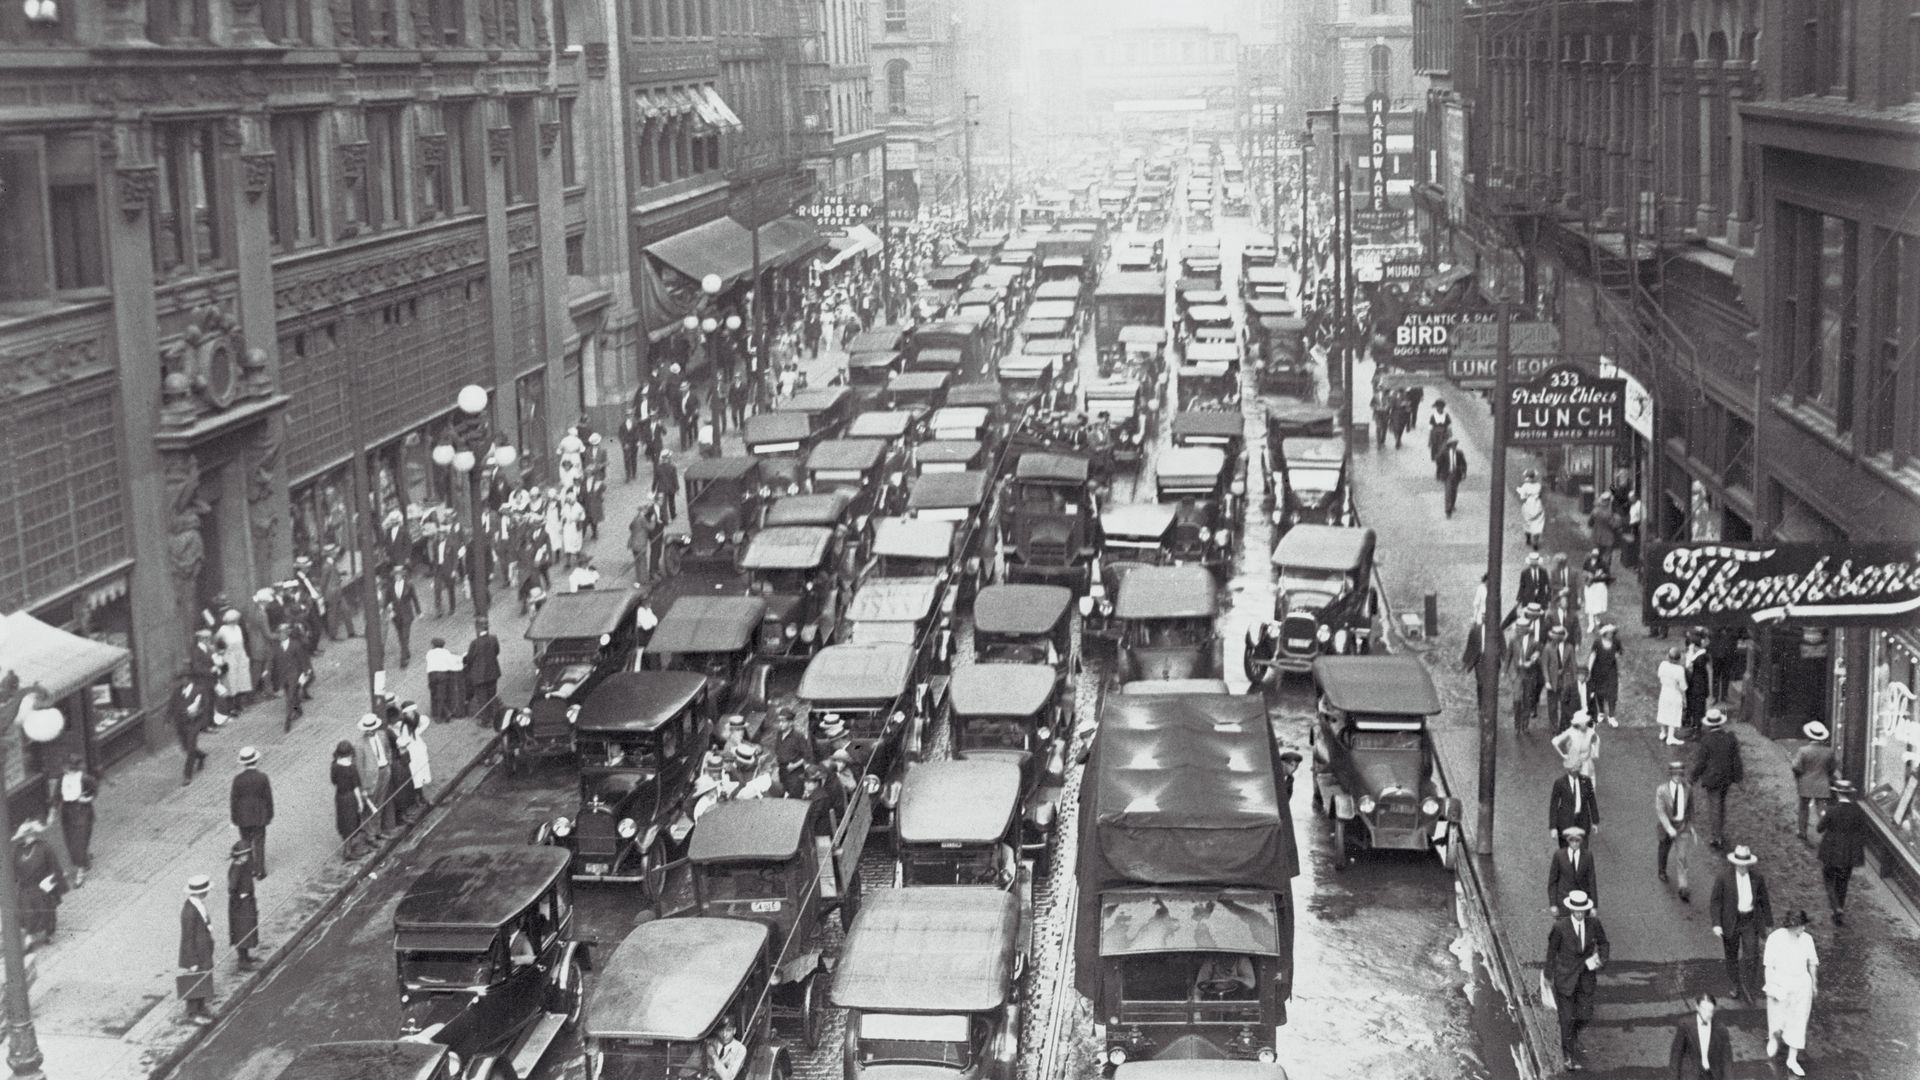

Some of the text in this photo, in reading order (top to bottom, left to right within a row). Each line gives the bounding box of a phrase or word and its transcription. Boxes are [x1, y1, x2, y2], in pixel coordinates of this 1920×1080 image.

[1372, 98, 1385, 211] HARDWARE
[824, 195, 843, 205] THE
[798, 203, 869, 217] RUBBER
[817, 216, 851, 226] STORE
[1386, 264, 1421, 278] MURAD
[1403, 313, 1457, 326] ATLANTIC
[1474, 312, 1519, 324] PACIC
[1396, 325, 1448, 345] BIRD
[1550, 370, 1580, 388] 333
[1516, 407, 1612, 428] LUNCH
[1514, 429, 1616, 439] BOSTON BAKED BEANS
